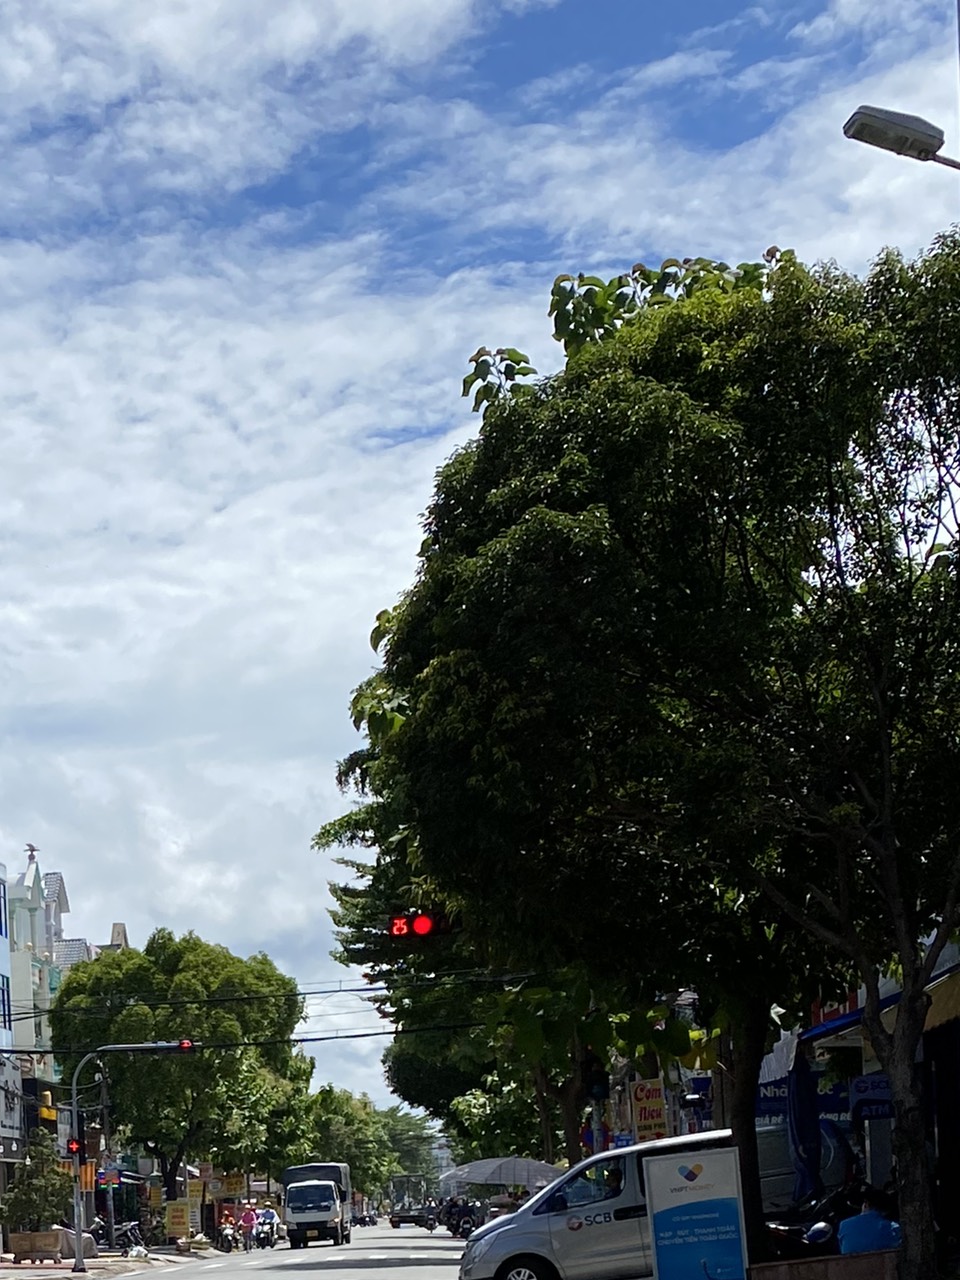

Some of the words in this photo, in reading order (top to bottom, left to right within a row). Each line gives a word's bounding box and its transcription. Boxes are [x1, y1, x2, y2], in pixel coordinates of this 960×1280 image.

[759, 1084, 789, 1098] Nhà
[861, 1104, 890, 1117] ATM
[584, 1212, 612, 1226] SCB
